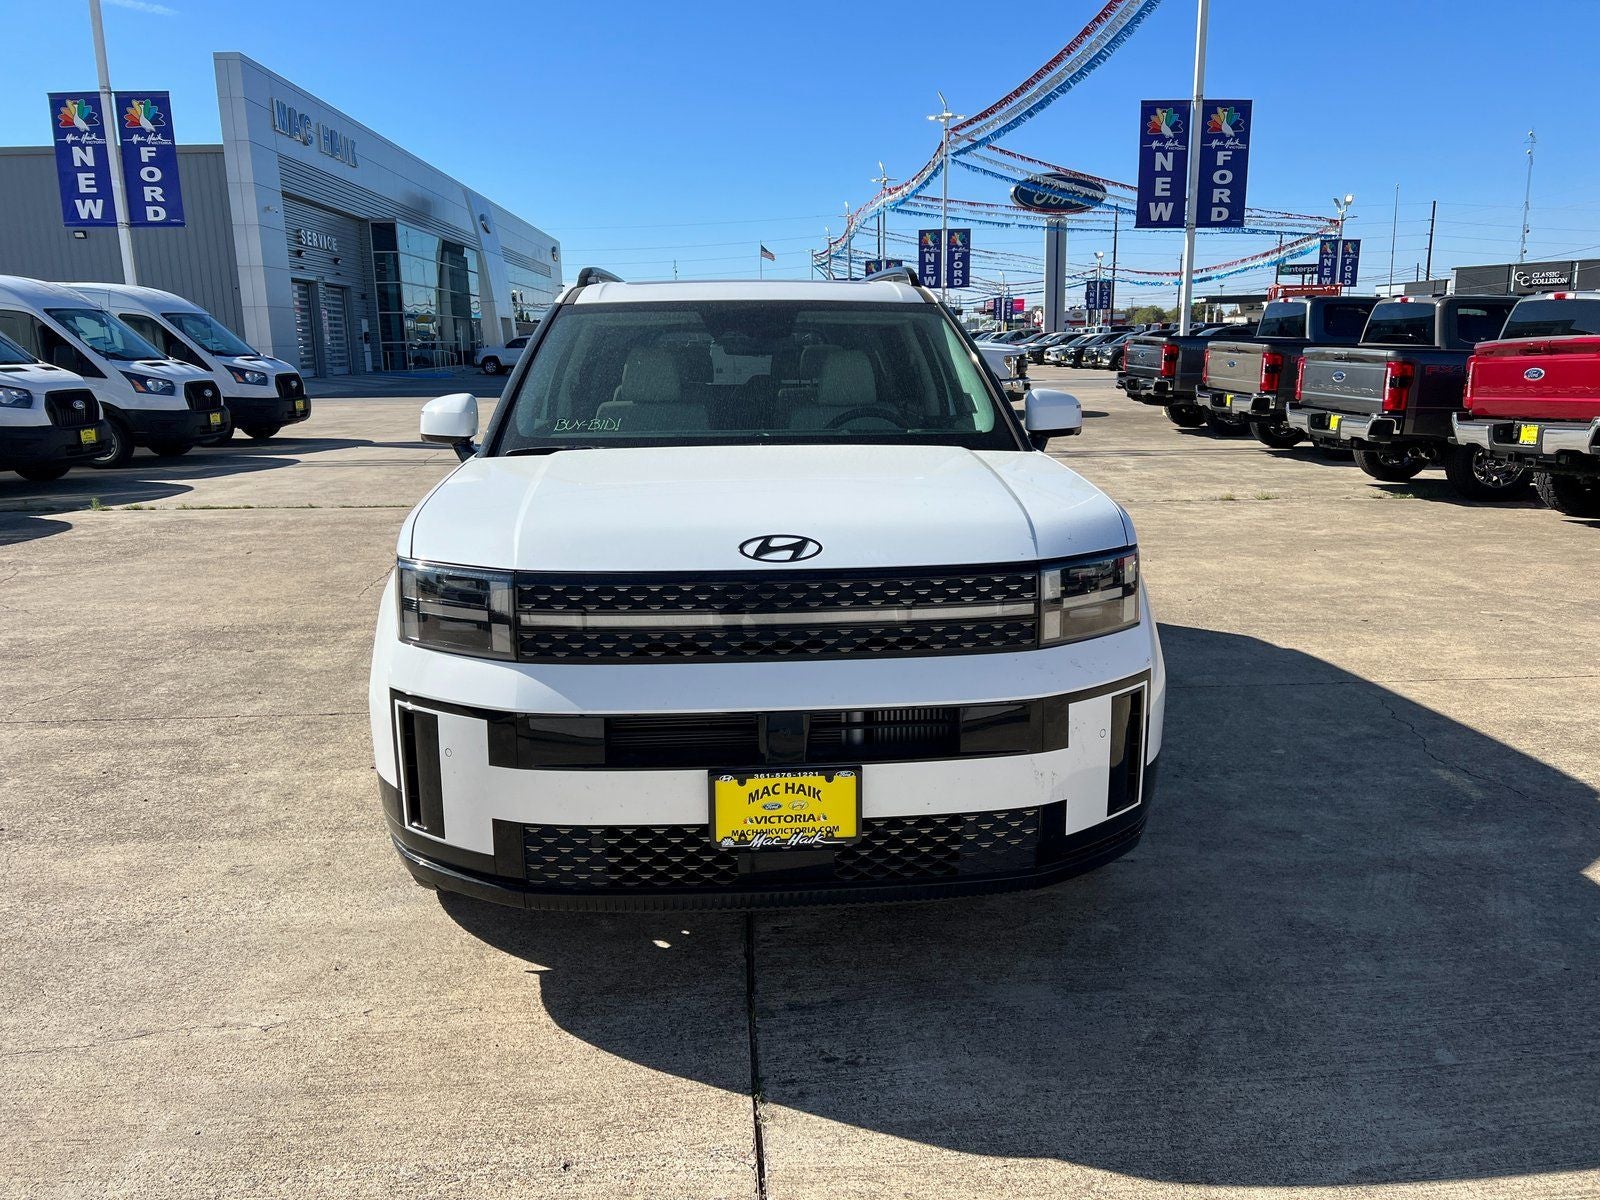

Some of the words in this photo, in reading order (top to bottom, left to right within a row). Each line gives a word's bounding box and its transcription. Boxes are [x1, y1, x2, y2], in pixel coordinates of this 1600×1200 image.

[271, 98, 313, 147] MAC
[317, 123, 358, 168] HAIK
[71, 146, 103, 219] NEW
[140, 146, 166, 221] FORD
[1148, 152, 1174, 222] NEW
[1210, 151, 1233, 222] FORD
[300, 229, 338, 252] SERVICE
[923, 252, 936, 286] NEW
[952, 252, 963, 286] FORD
[1281, 265, 1319, 273] enterpri
[1321, 258, 1332, 285] NEW
[1344, 259, 1353, 285] FORD
[747, 783, 781, 805] MAC
[784, 782, 822, 802] HAIK
[754, 814, 816, 824] VICTORIA
[749, 831, 782, 848] Mac
[786, 830, 823, 846] Haik
